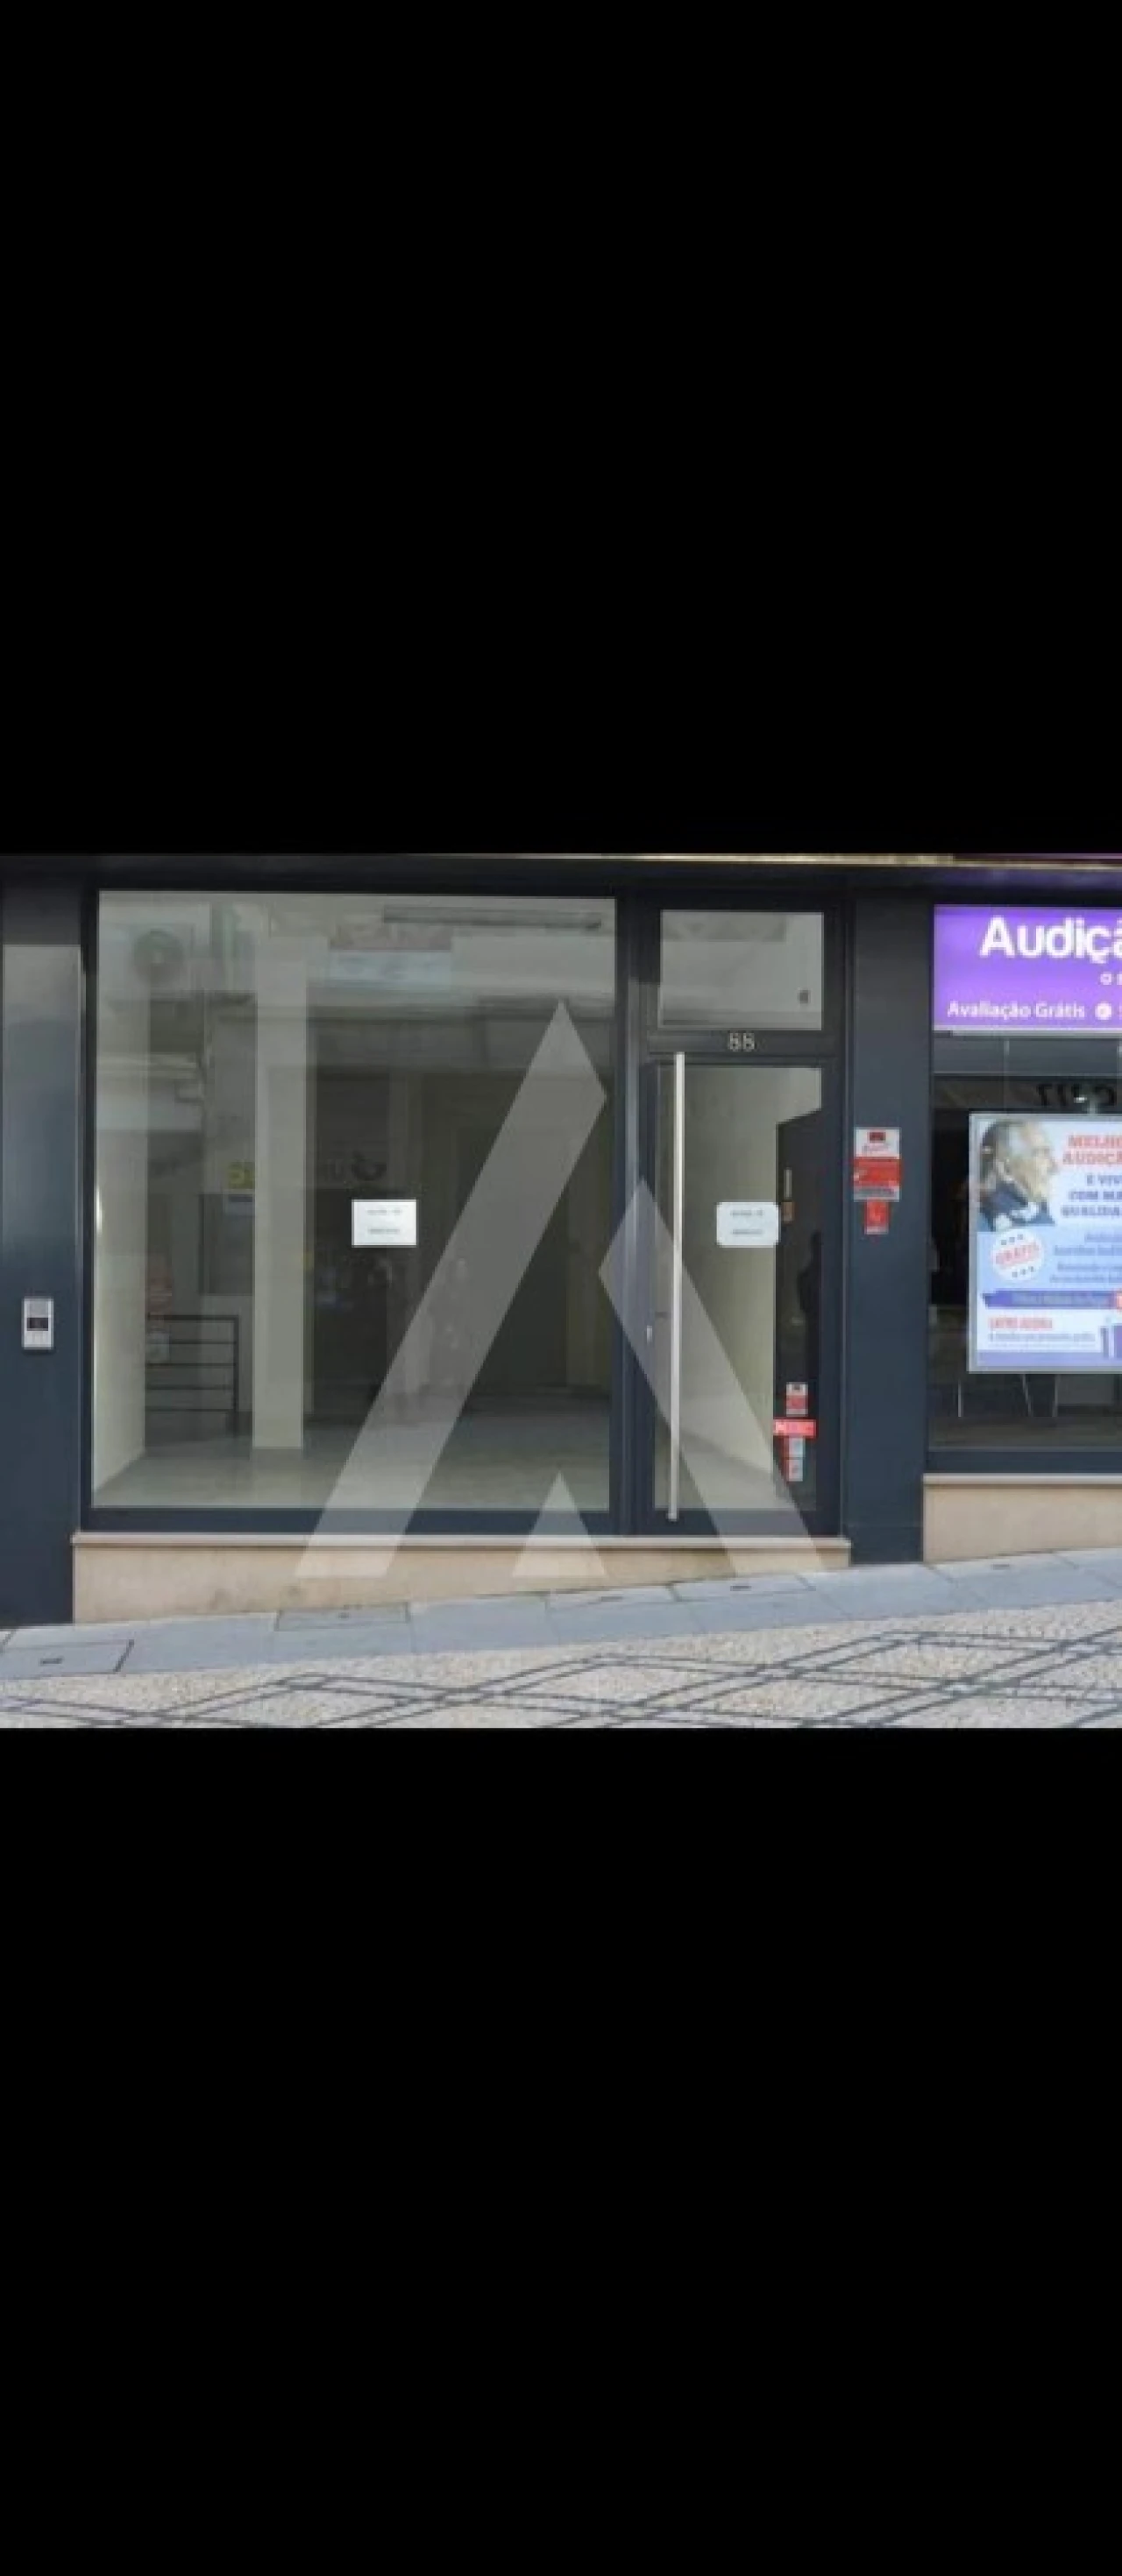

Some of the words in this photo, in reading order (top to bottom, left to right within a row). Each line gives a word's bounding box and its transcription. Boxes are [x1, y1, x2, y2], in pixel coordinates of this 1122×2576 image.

[948, 1001, 1032, 1020] Avaliação
[1035, 1001, 1085, 1018] Grátis
[728, 1031, 756, 1051] 88
